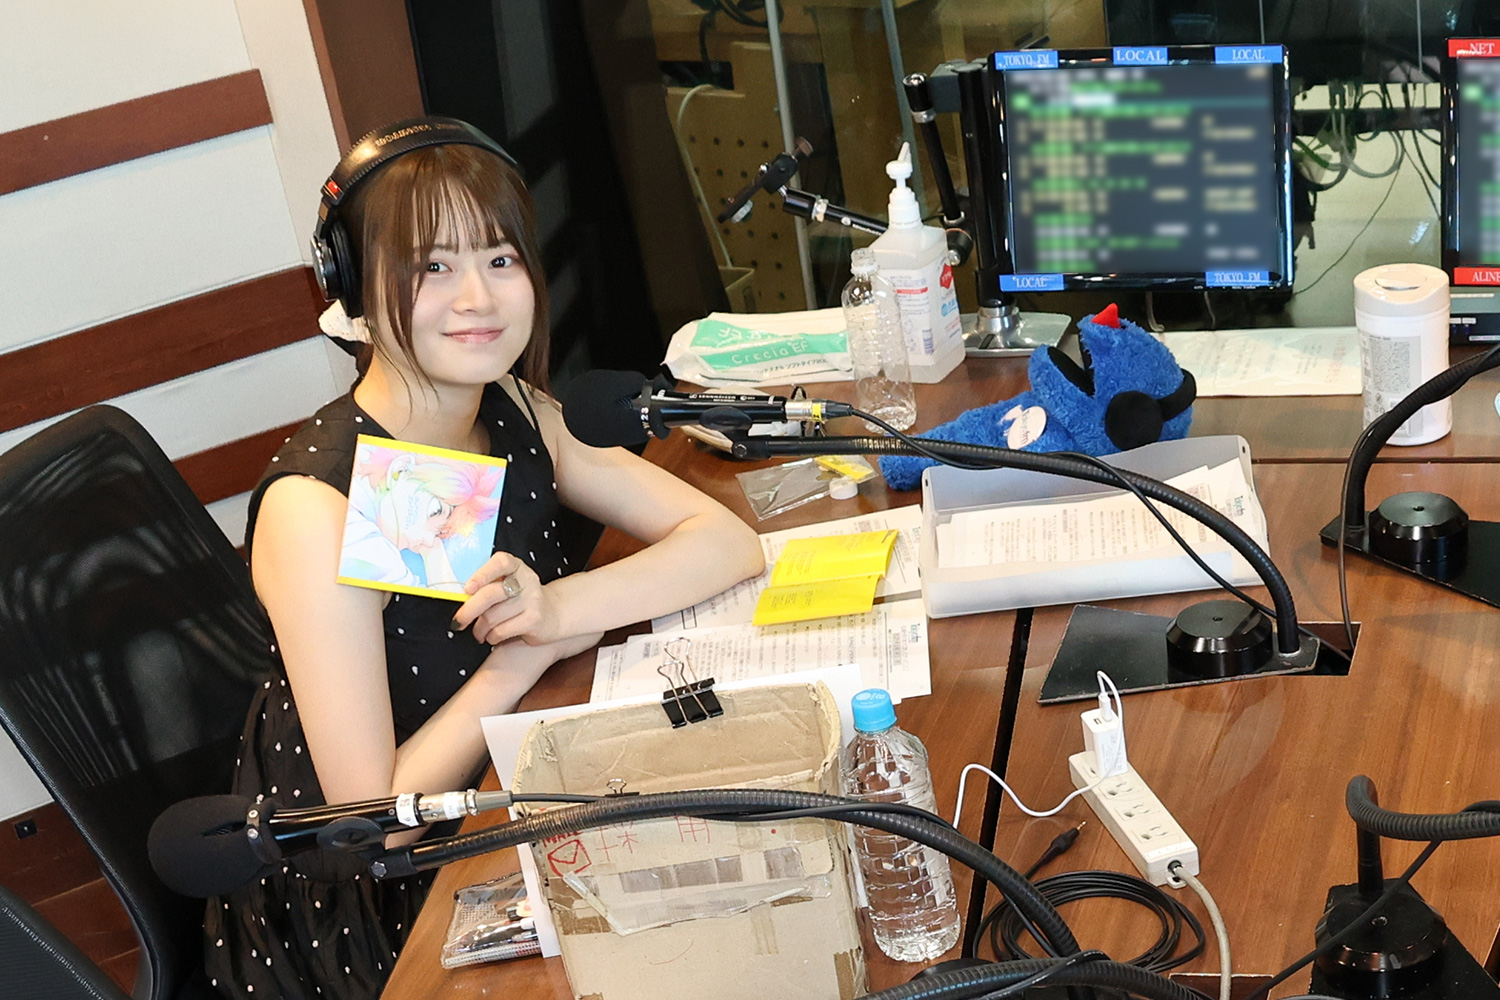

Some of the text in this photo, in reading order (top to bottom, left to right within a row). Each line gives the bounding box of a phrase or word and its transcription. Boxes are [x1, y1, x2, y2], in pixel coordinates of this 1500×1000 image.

[1232, 49, 1265, 60] LOCAL
[1470, 43, 1495, 55] NET
[1116, 50, 1165, 62] LOCAL
[1015, 277, 1048, 288] LOCAL
[732, 347, 788, 364] Crecia
